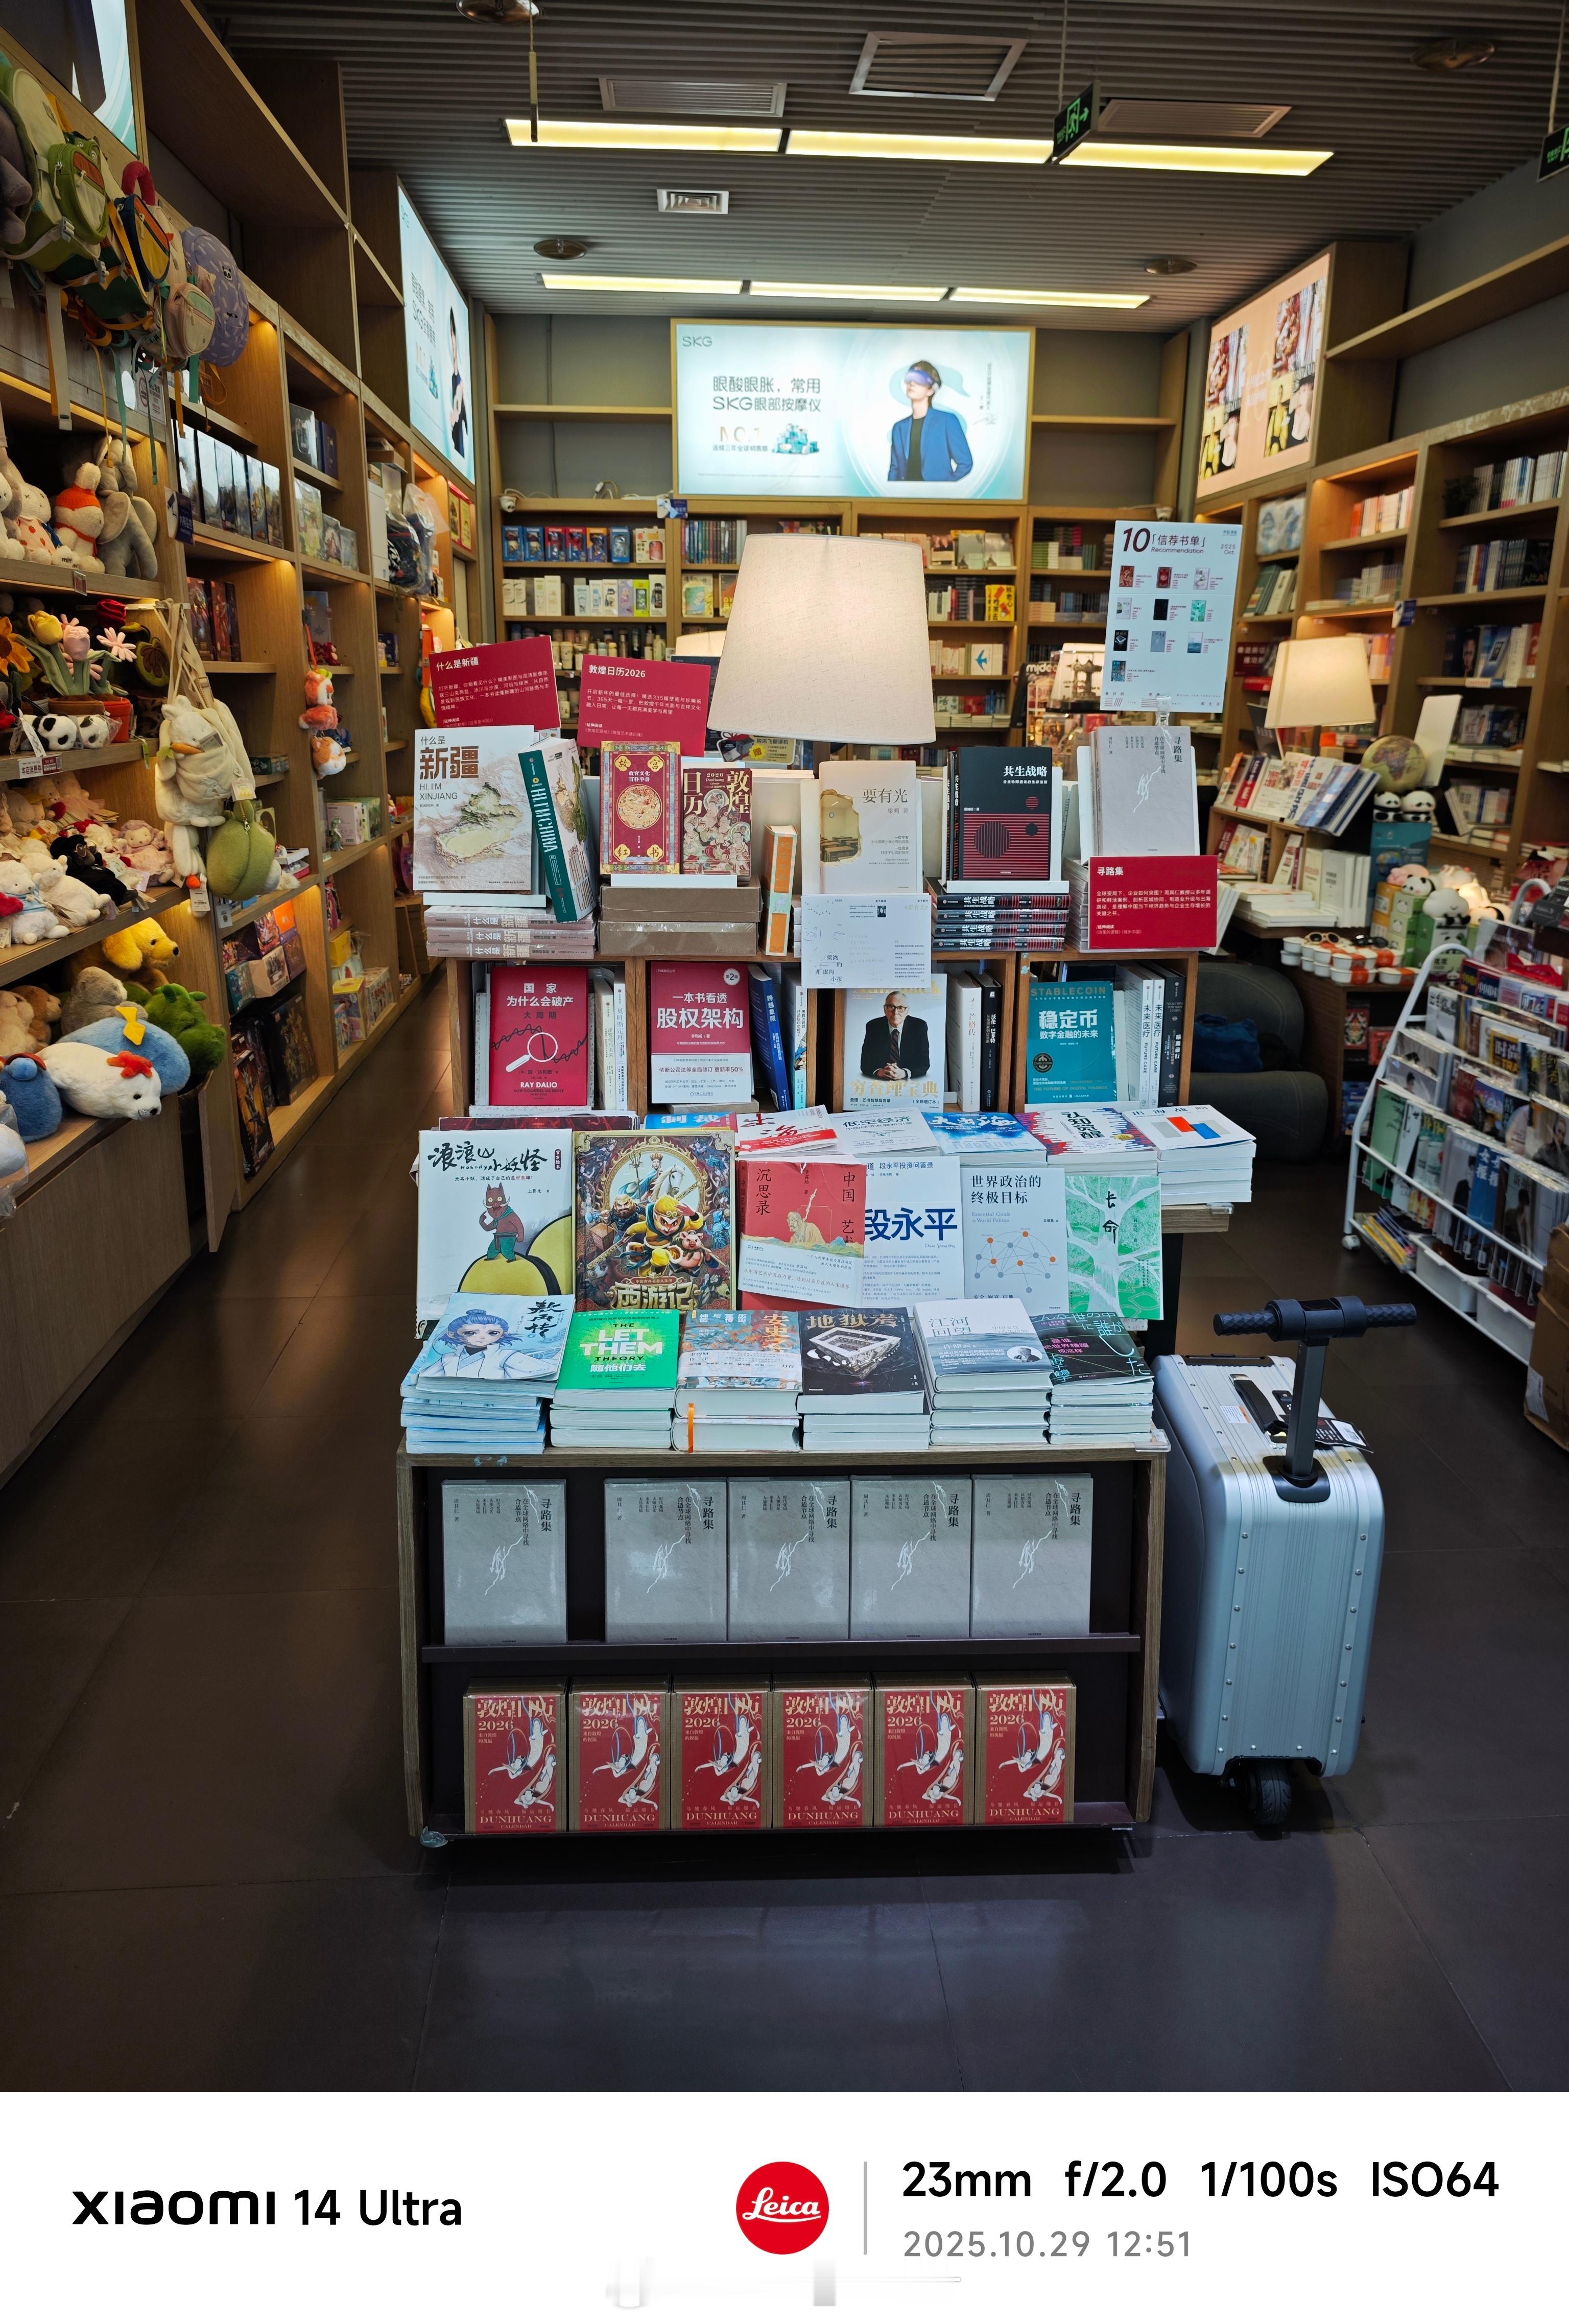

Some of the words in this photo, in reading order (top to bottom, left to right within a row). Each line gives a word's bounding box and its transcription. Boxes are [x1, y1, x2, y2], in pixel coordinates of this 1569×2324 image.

[682, 336, 712, 347] SKG
[712, 396, 821, 412] SKG眼部按摩仪
[1123, 528, 1151, 552] 10
[437, 657, 479, 671] 什么是新疆
[589, 665, 646, 678] 敦煌日历2026
[421, 736, 446, 745] 什么是
[1174, 737, 1182, 763] 寻路集
[420, 746, 479, 780] 新疆
[618, 758, 628, 768] 故
[650, 759, 660, 770] 宫
[1004, 766, 1048, 777] 共生战略
[420, 792, 458, 800] XINJIANG
[683, 771, 703, 815] 日历
[726, 770, 750, 815] 敦煌
[862, 788, 908, 804] 要有光
[537, 817, 558, 853] CHINA
[1097, 867, 1124, 875] 寻路集
[473, 915, 528, 928] 什么是新疆
[964, 911, 995, 919] 共生战略
[476, 930, 531, 943] 什么是新疆
[475, 944, 531, 957] 什么是新疆
[524, 983, 557, 993] 国家
[1031, 987, 1106, 996] STABLECOIN
[507, 996, 574, 1007] 为什么会破产
[673, 992, 727, 1004] 一本书看透
[657, 1008, 743, 1029] 股权架构
[1039, 1009, 1098, 1029] 稳定币
[1143, 1004, 1151, 1037] 未来医疗
[1153, 1004, 1162, 1037] 未来医疗
[1040, 1030, 1099, 1039] 数字金融的未来
[850, 1079, 938, 1098] 穷查理宝典
[843, 1117, 911, 1127] 低空经济
[1061, 1112, 1105, 1140] 认知觉醒
[971, 1175, 1041, 1188] 世界政治的
[756, 1169, 772, 1216] 沉思录
[971, 1191, 1028, 1204] 终极目标
[865, 1207, 958, 1241] 段永平
[615, 1282, 697, 1310] 西游记
[928, 1317, 969, 1327] 江河
[599, 1329, 650, 1342] LET
[580, 1341, 663, 1356] THEM
[590, 1364, 646, 1372] 随他们去
[540, 1498, 552, 1532] 寻路集
[702, 1496, 714, 1529] 寻路集
[826, 1495, 838, 1529] 寻路集
[948, 1493, 959, 1527] 寻路集
[1070, 1492, 1081, 1526] 寻路集
[478, 1720, 513, 1731] 2026
[583, 1719, 618, 1729] 2026
[685, 1718, 719, 1728] 2026
[786, 1717, 820, 1728] 2026
[888, 1716, 922, 1727] 2026
[990, 1714, 1024, 1725] 2026
[480, 1815, 552, 1823] DUNHUANG
[584, 1814, 655, 1822] DUNHUANG
[686, 1812, 757, 1820] DUNHUANG
[789, 1812, 858, 1820] DUNHUANG
[889, 1811, 959, 1819] DUNHUANG
